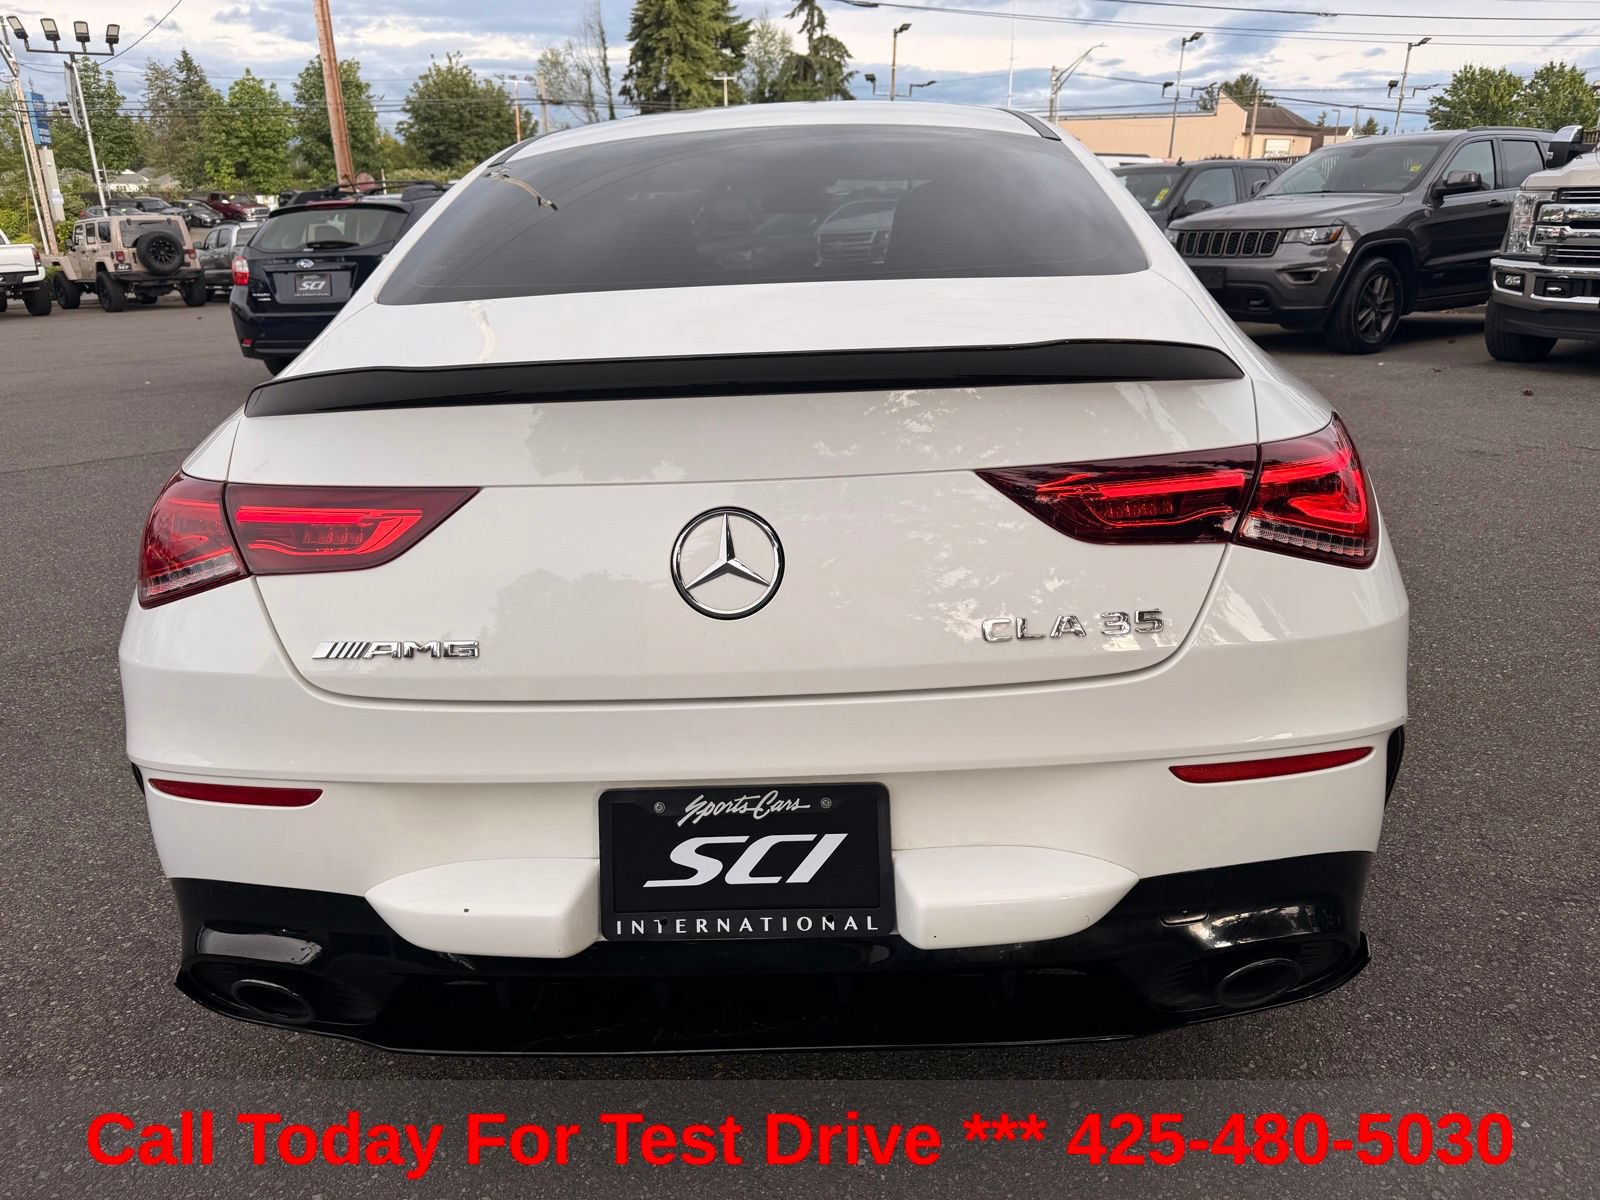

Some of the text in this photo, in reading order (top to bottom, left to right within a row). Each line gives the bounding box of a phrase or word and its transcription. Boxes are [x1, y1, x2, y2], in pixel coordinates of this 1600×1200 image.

[299, 280, 326, 291] SCI
[982, 608, 1165, 643] CLA 35
[677, 790, 811, 827] Sports Cars
[643, 833, 849, 888] SCI
[616, 915, 880, 935] INTERNATIONAL
